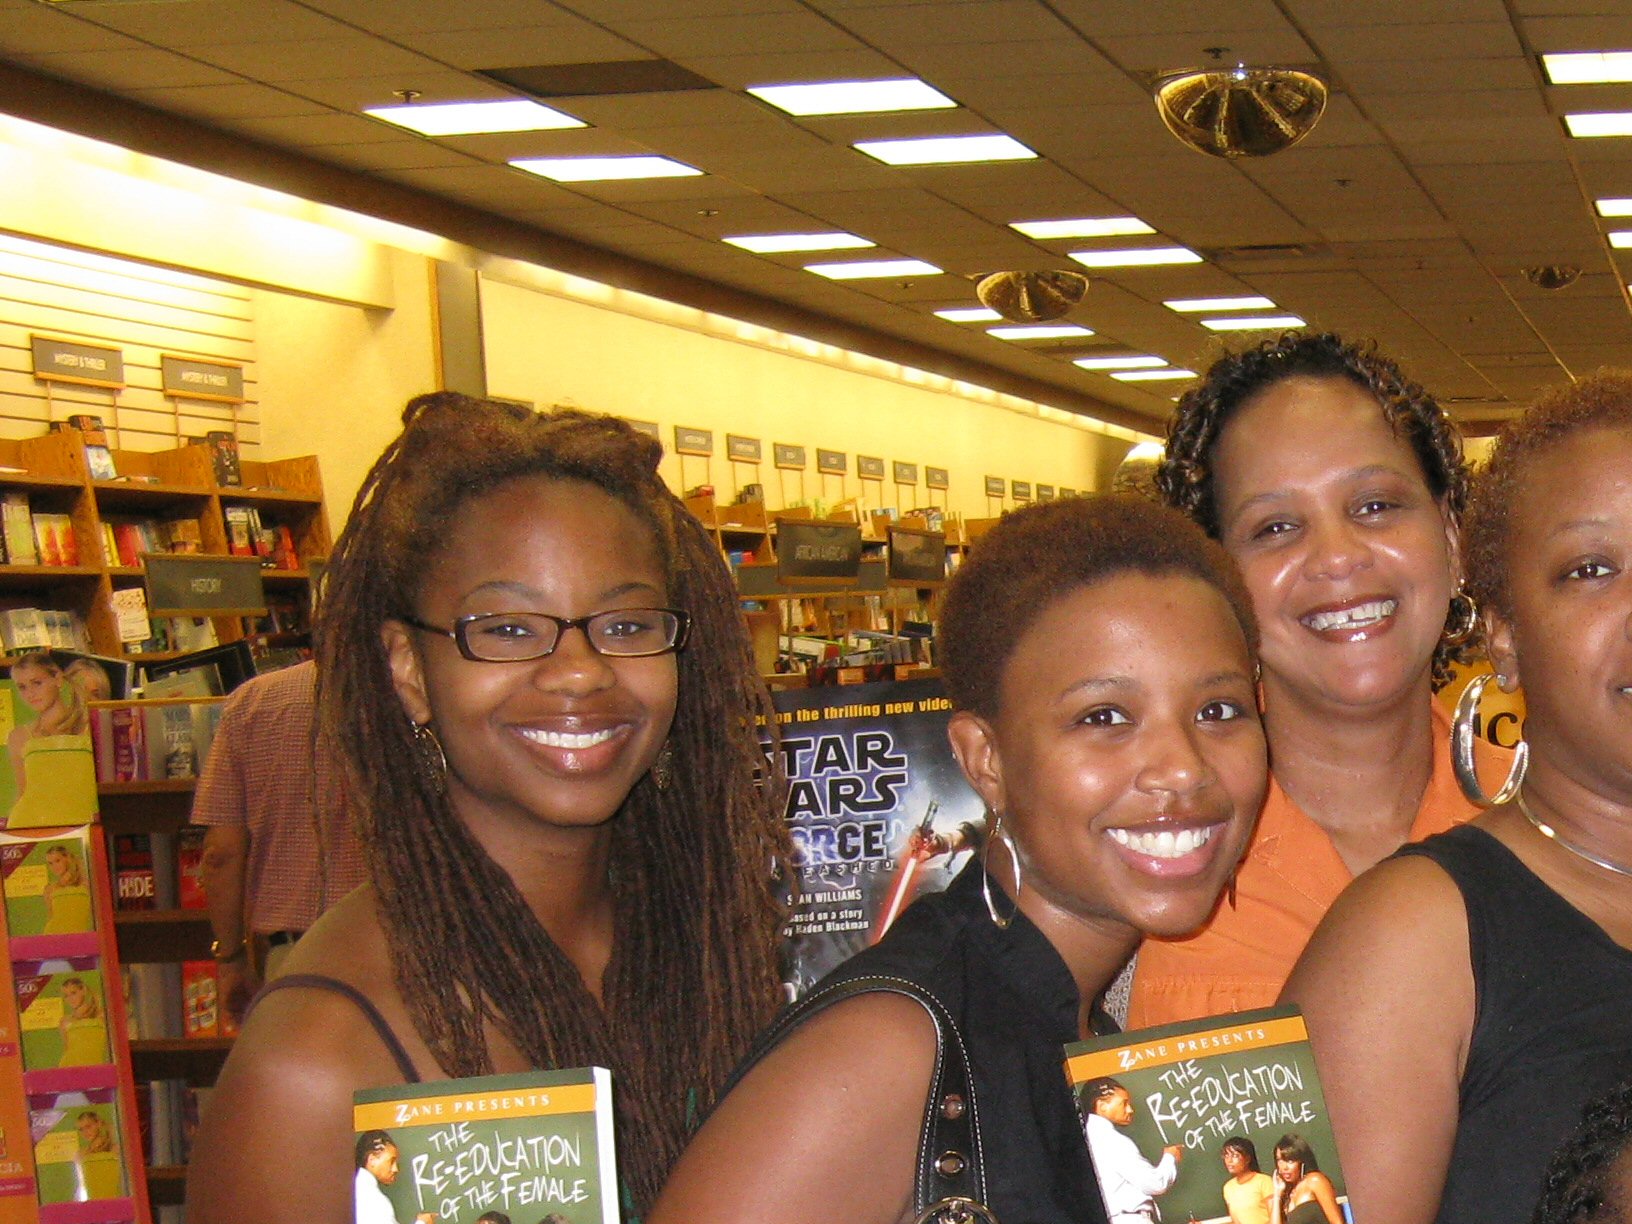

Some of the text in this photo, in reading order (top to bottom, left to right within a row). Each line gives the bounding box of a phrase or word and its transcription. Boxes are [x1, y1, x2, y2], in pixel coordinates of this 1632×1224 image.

[191, 578, 222, 593] HISTORY
[797, 709, 819, 722] the
[824, 704, 880, 720] thrilling
[885, 701, 914, 715] new
[919, 698, 952, 712] vide
[783, 772, 908, 820] ARS
[787, 889, 862, 905] SAN WILLIAMS
[789, 912, 815, 922] ased
[817, 912, 828, 920] on
[840, 909, 863, 920] story
[825, 921, 869, 932] Blackman
[1177, 1029, 1265, 1053] PRESENTS
[1158, 1059, 1203, 1090] THE
[454, 1094, 550, 1113] PRESENTS
[1146, 1061, 1303, 1144] RE-EDUCATION
[428, 1121, 475, 1153] THE
[1185, 1100, 1316, 1151] OF THE FEMALE
[411, 1130, 581, 1211] RE-EDUCATION
[440, 1172, 589, 1223] OF THE FEMALE
